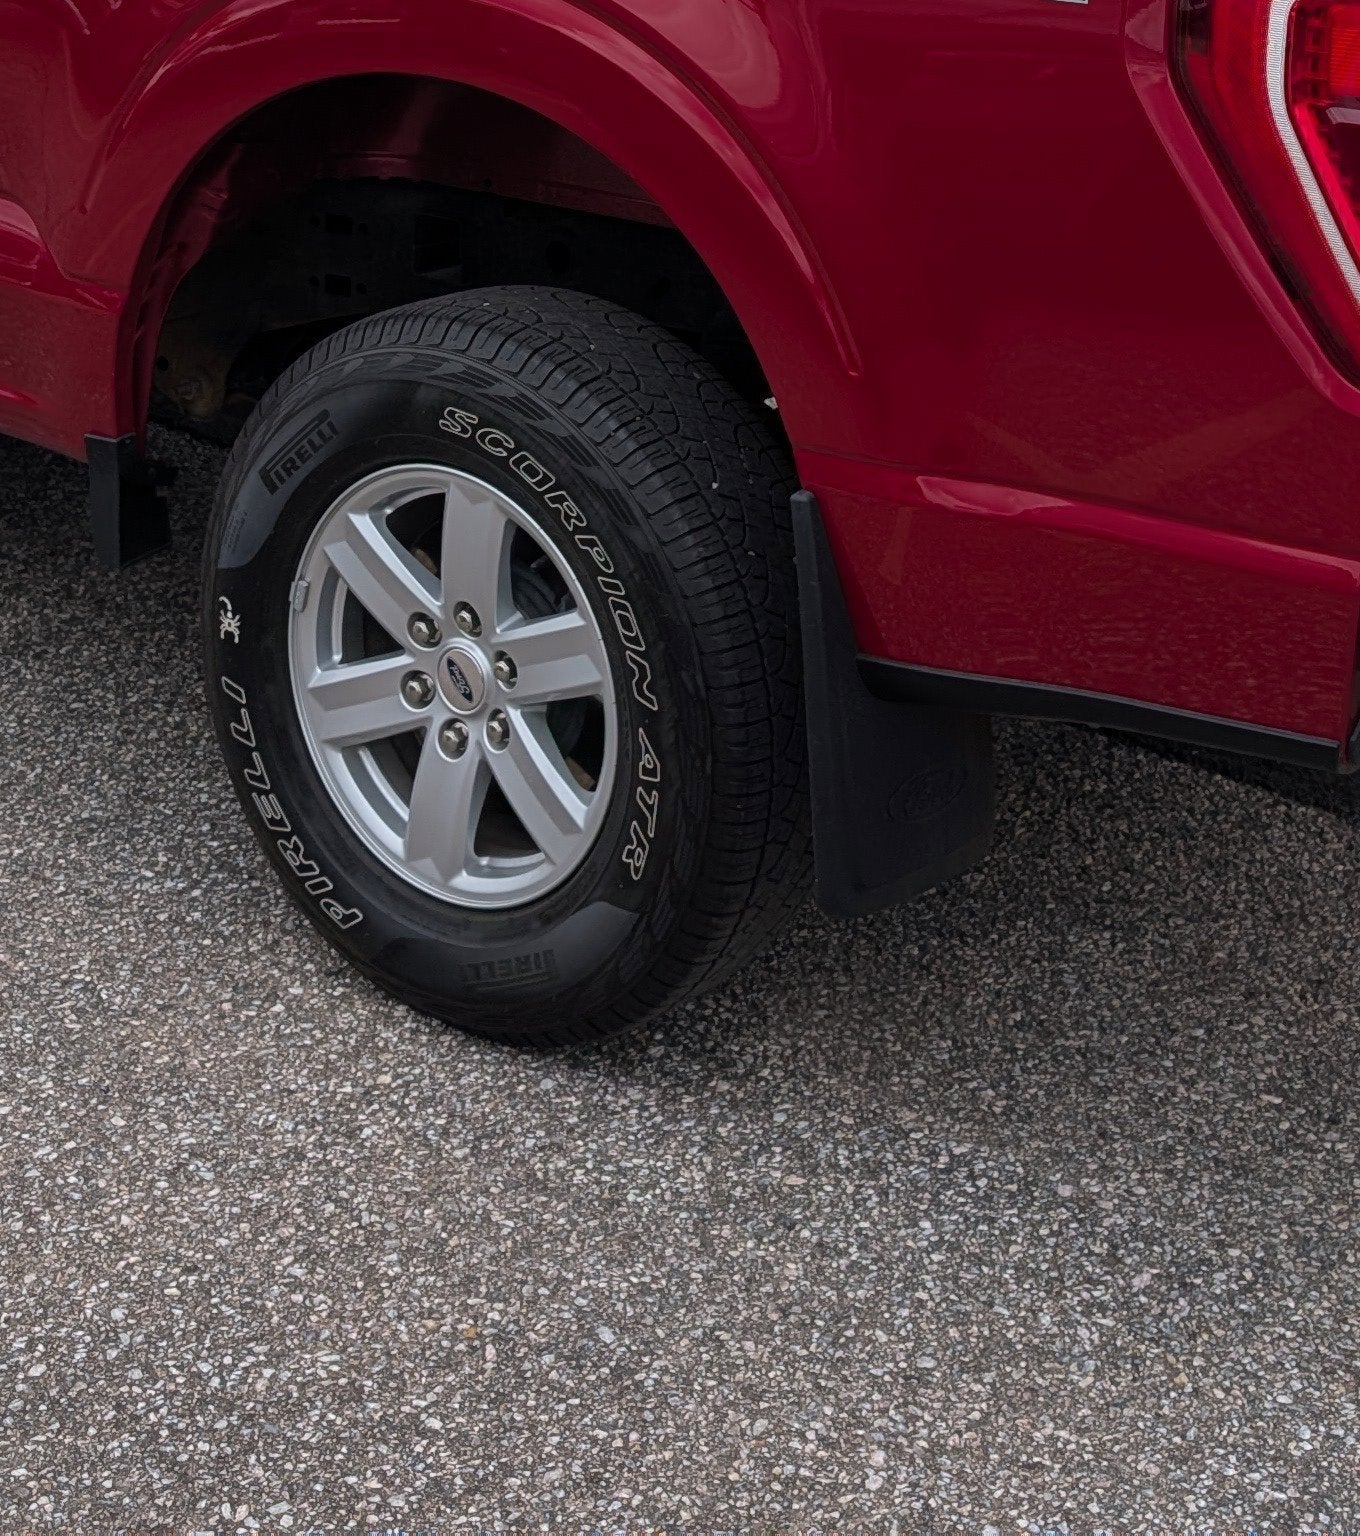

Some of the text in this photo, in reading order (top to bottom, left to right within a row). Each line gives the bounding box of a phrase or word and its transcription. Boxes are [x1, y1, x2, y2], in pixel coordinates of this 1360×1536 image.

[258, 408, 340, 496] PIRELLI
[439, 405, 661, 880] SCORPION ATR
[222, 676, 363, 930] PIRELLI
